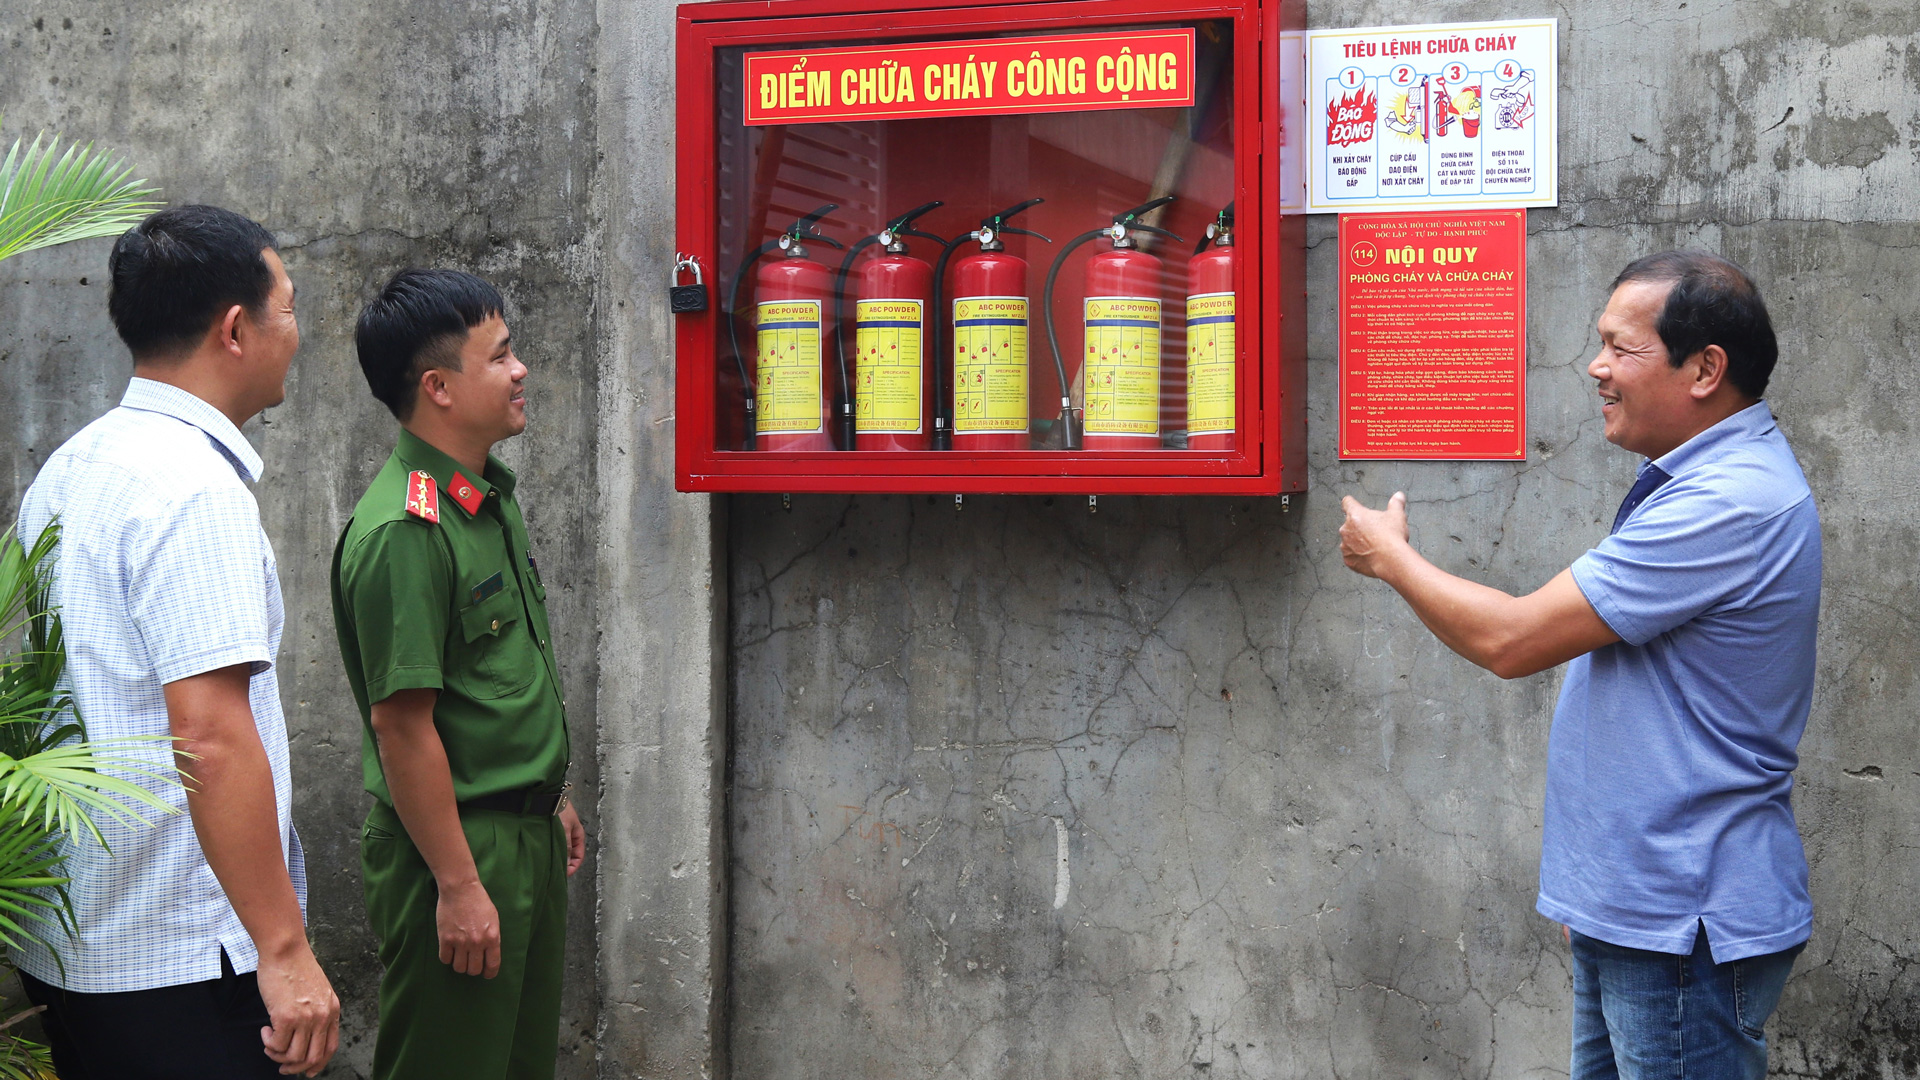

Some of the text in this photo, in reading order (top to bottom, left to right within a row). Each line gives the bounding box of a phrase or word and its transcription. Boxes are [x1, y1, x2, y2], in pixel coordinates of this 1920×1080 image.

[1343, 33, 1517, 59] TIÊU LỆNH CHỮA CHÁY
[1398, 68, 1408, 82] 2
[1450, 65, 1460, 80] 3
[1503, 63, 1513, 77] 4
[759, 46, 1177, 109] ĐIỂM CHỮA CHÁY CÔNG CỘNG
[1347, 70, 1354, 85] 1
[1337, 104, 1363, 122] BÁO
[1331, 121, 1372, 148] ĐỘNG
[1332, 152, 1372, 164] KHI XẢY CHÁY
[1389, 152, 1402, 162] CÚP
[1491, 149, 1525, 158] ĐIỆN THOẠI
[1338, 165, 1367, 176] BÁO ĐỘNG
[1388, 165, 1401, 174] DAO
[1437, 169, 1449, 177] CÁT
[1515, 166, 1531, 174] CHÁY
[1382, 174, 1424, 186] NƠI XẢY CHÁY
[1358, 222, 1379, 231] CỘNG
[1380, 222, 1397, 230] HÒA
[1410, 221, 1424, 229] HỘI
[1425, 220, 1441, 229] CHỦ
[1443, 220, 1468, 228] NGHĨA
[1469, 220, 1487, 228] VIỆT
[1392, 231, 1408, 239] LẬP
[1415, 230, 1425, 238] TỰ
[1443, 230, 1465, 238] HẠNH
[1354, 245, 1478, 268] 114 NỘI QUY
[1350, 268, 1514, 283] PHÒNG CHÁY VÀ CHỮA CHÁY
[1127, 304, 1157, 312] POWDER
[1200, 300, 1232, 309] POWDER
